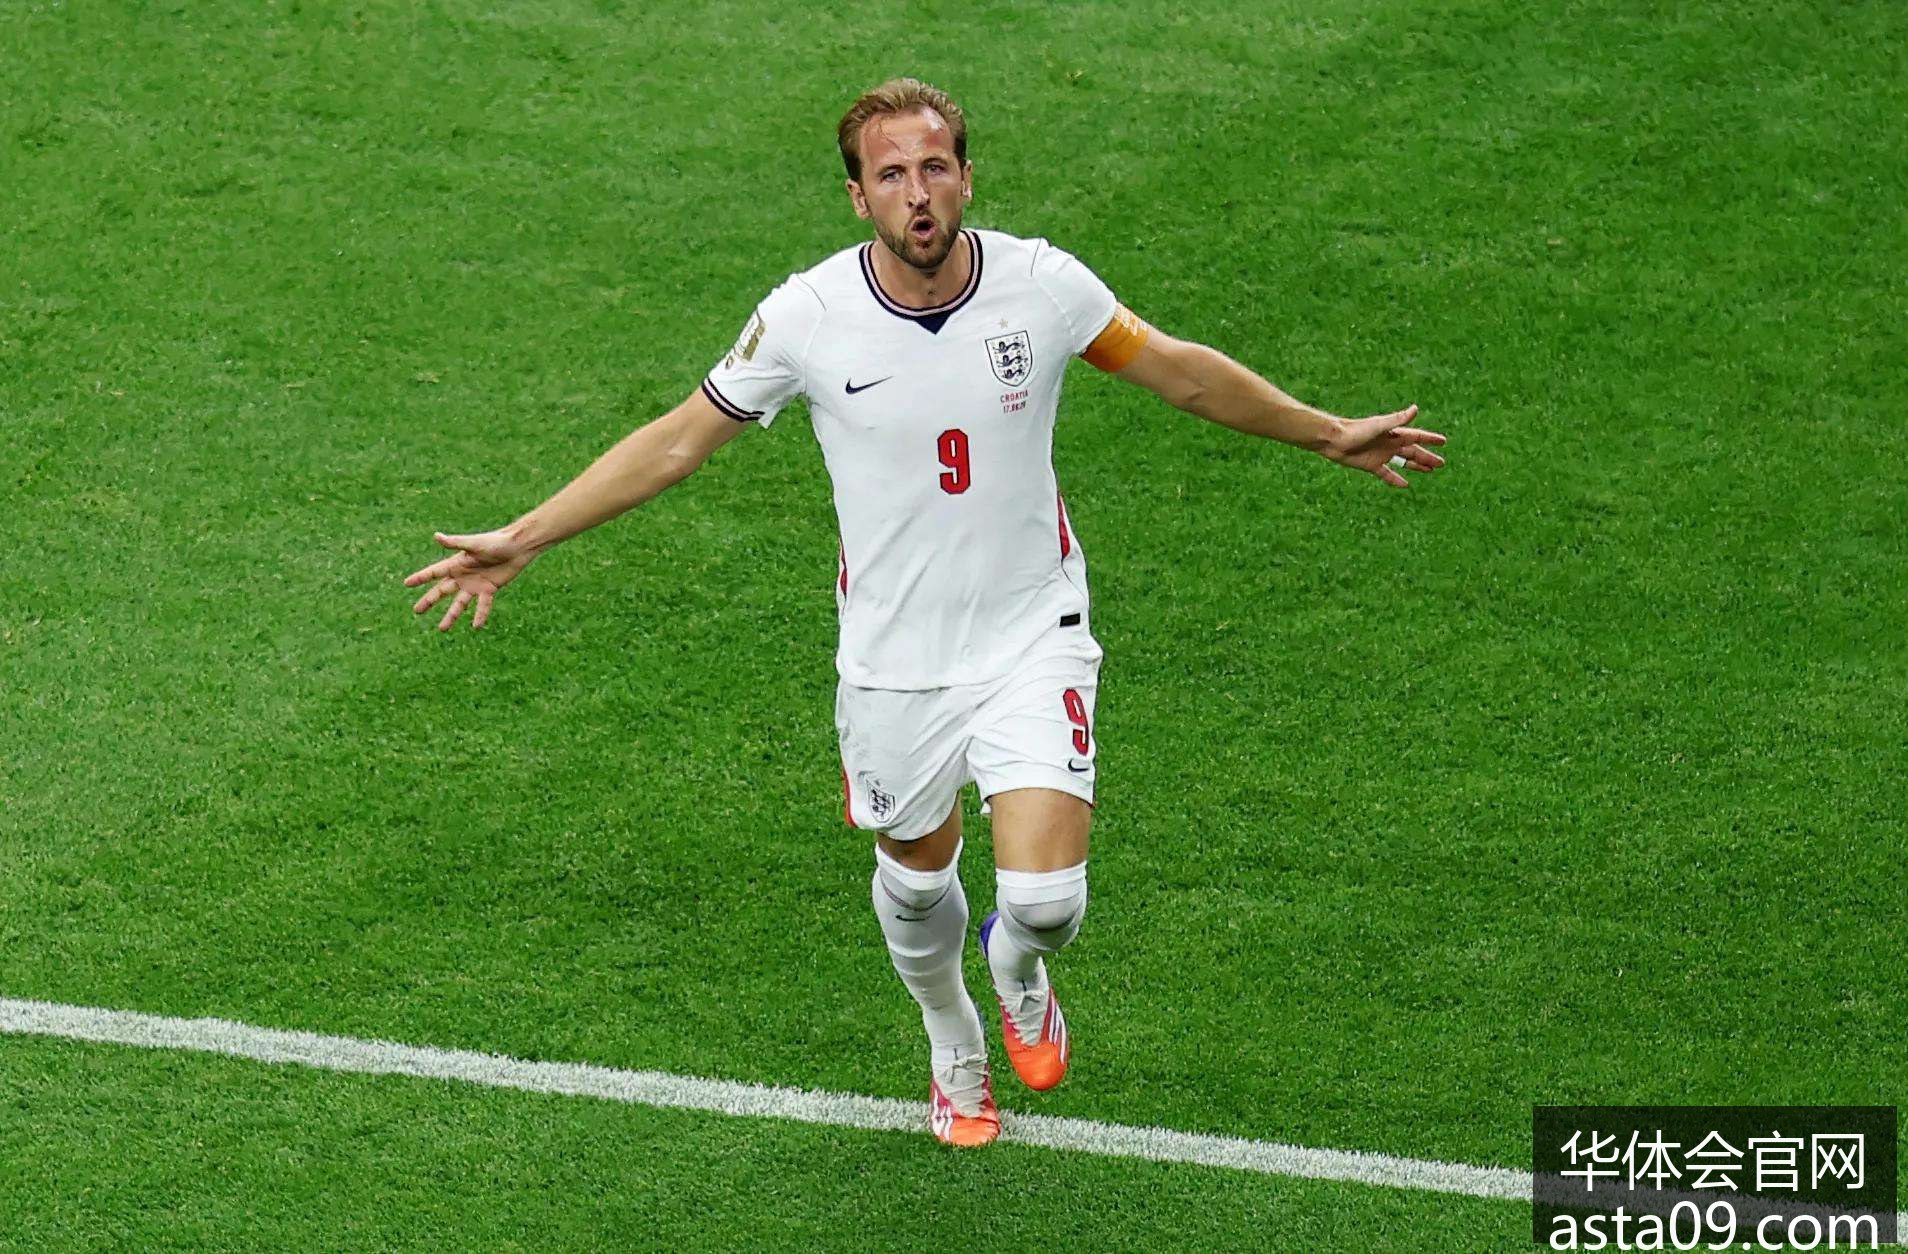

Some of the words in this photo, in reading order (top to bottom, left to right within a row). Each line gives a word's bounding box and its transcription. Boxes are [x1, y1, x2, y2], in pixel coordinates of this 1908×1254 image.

[1000, 389, 1029, 403] CROATIA
[937, 428, 971, 495] 9
[1062, 688, 1090, 756] 9
